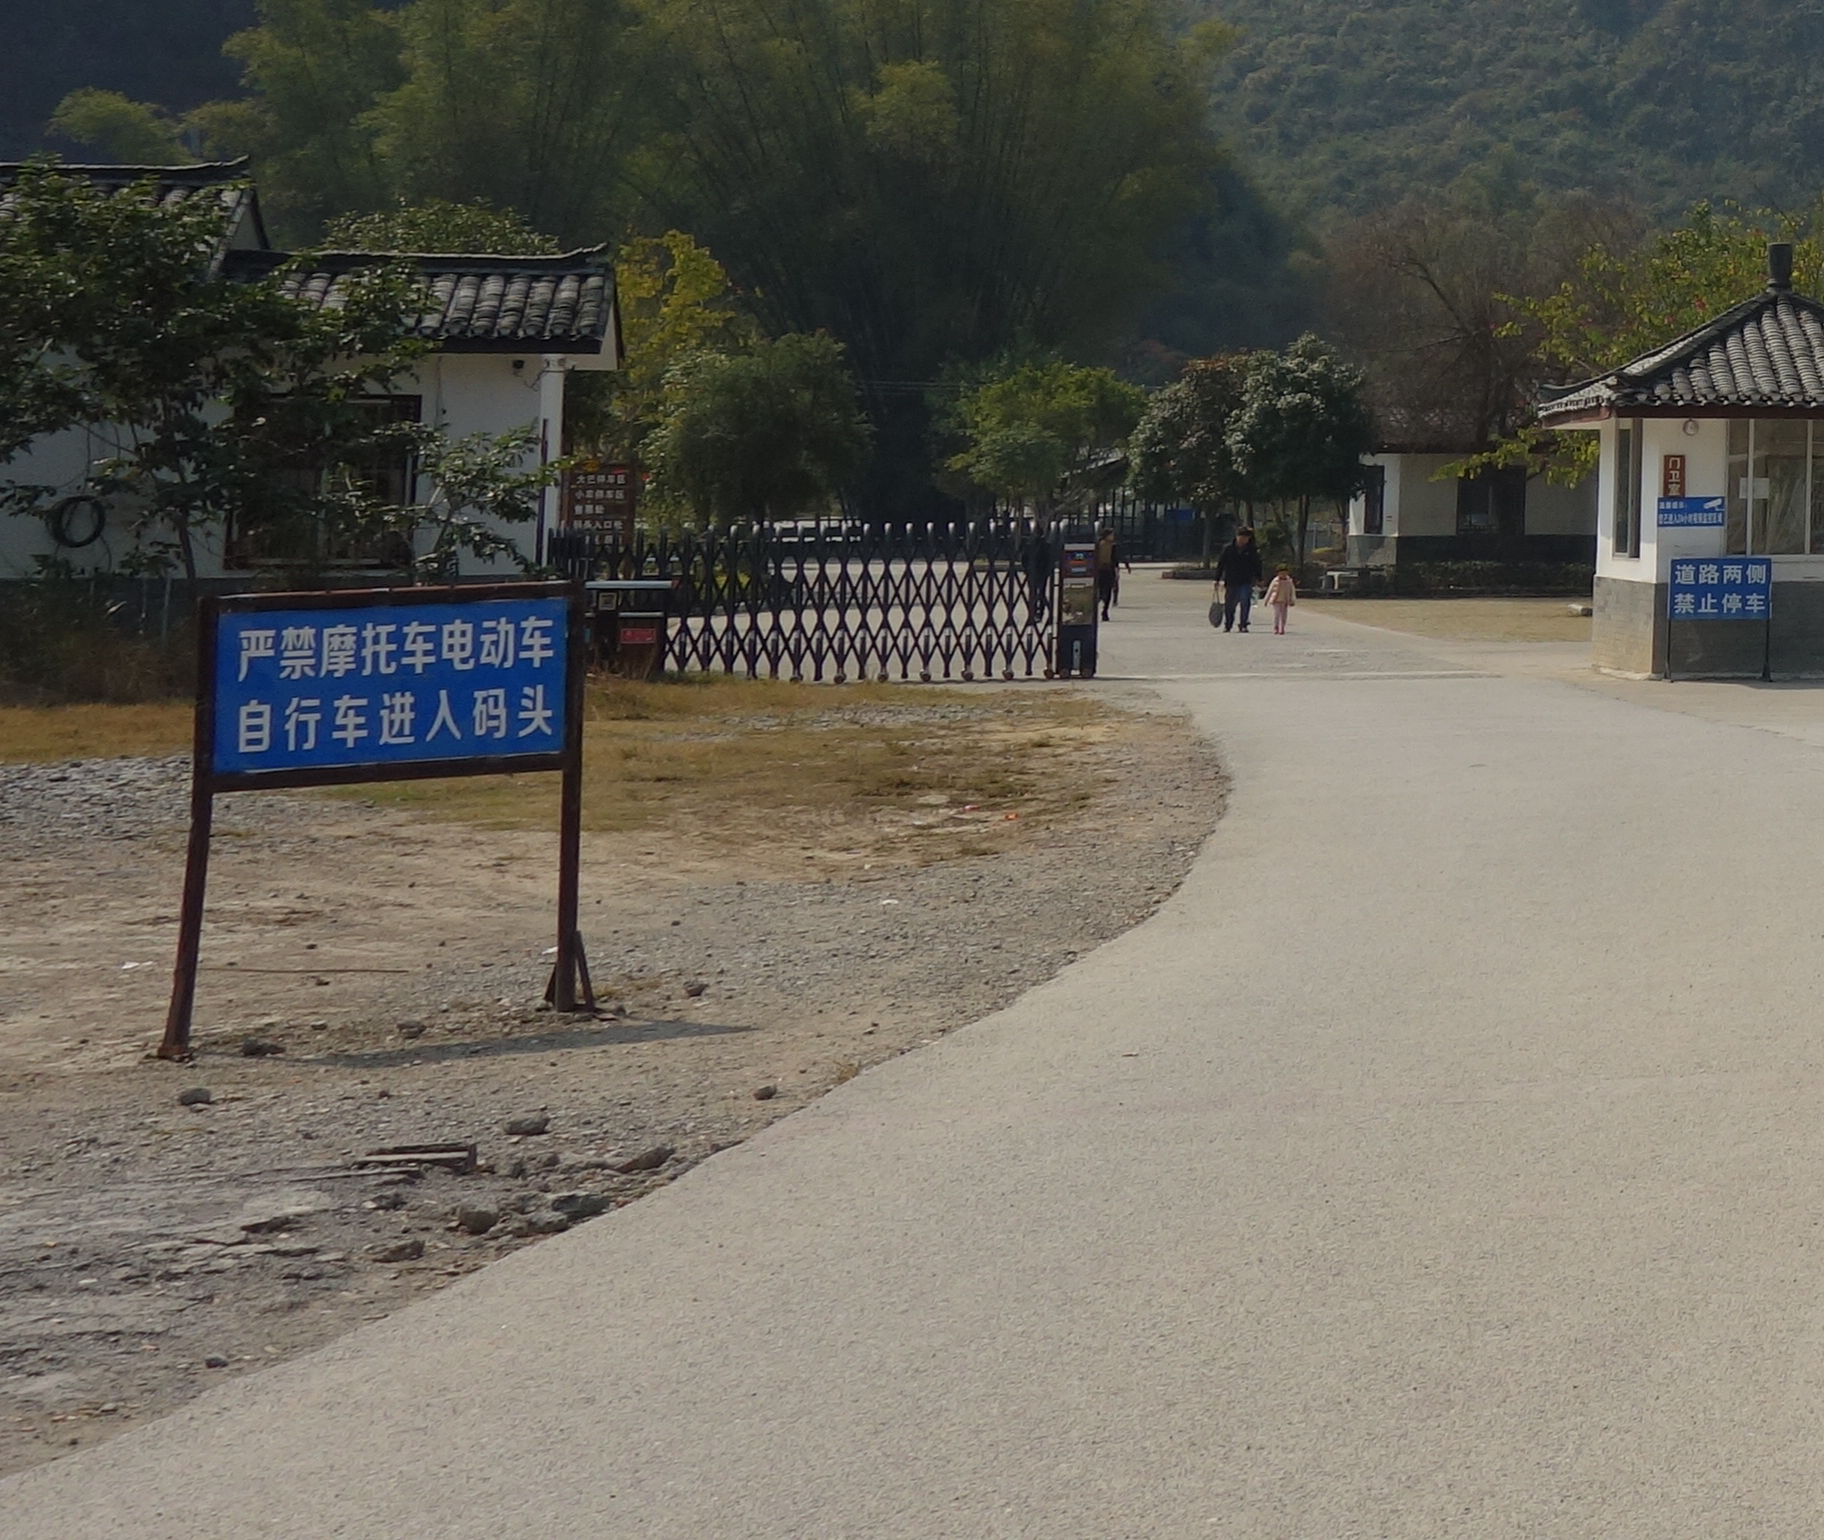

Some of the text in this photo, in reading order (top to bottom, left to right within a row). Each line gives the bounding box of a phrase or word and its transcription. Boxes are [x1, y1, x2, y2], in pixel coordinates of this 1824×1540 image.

[1668, 457, 1681, 496] 门卫室
[1674, 563, 1767, 585] 道路两侧
[1673, 592, 1766, 614] 禁止停车
[237, 615, 554, 683] 严禁摩托车电动车
